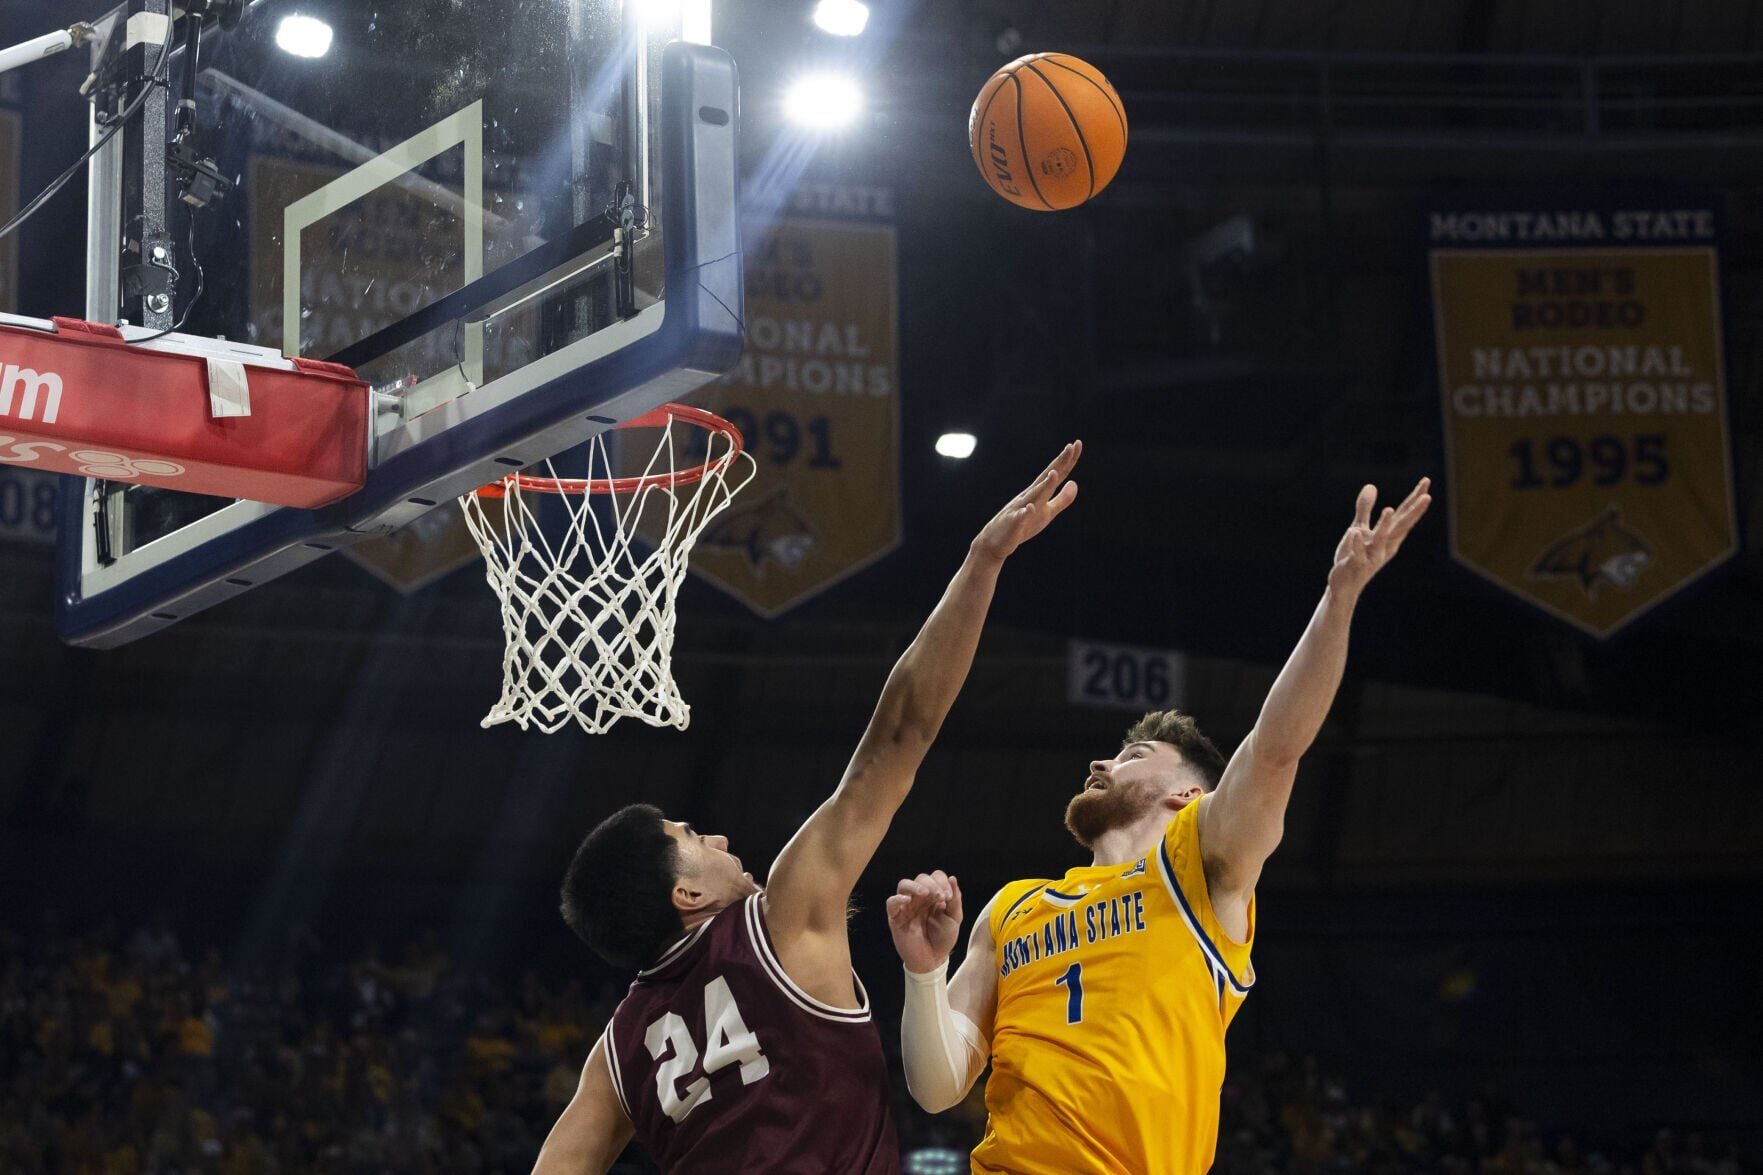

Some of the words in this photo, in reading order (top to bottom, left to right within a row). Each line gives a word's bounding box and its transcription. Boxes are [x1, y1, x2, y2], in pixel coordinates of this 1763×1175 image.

[1430, 211, 1604, 241] MONTANA
[1613, 209, 1715, 239] STATE
[1516, 267, 1635, 296] MEN'S
[746, 316, 871, 358] ONAL
[1511, 301, 1646, 330] RODEO
[719, 353, 889, 397] MPIONS
[1472, 344, 1694, 379] NATIONAL
[1452, 382, 1716, 418] CHAMPIONS
[1509, 433, 1670, 489] 1995
[1083, 650, 1169, 704] 206
[1085, 890, 1146, 943] STATE
[1055, 962, 1083, 1025] 1
[644, 975, 770, 1125] 24
